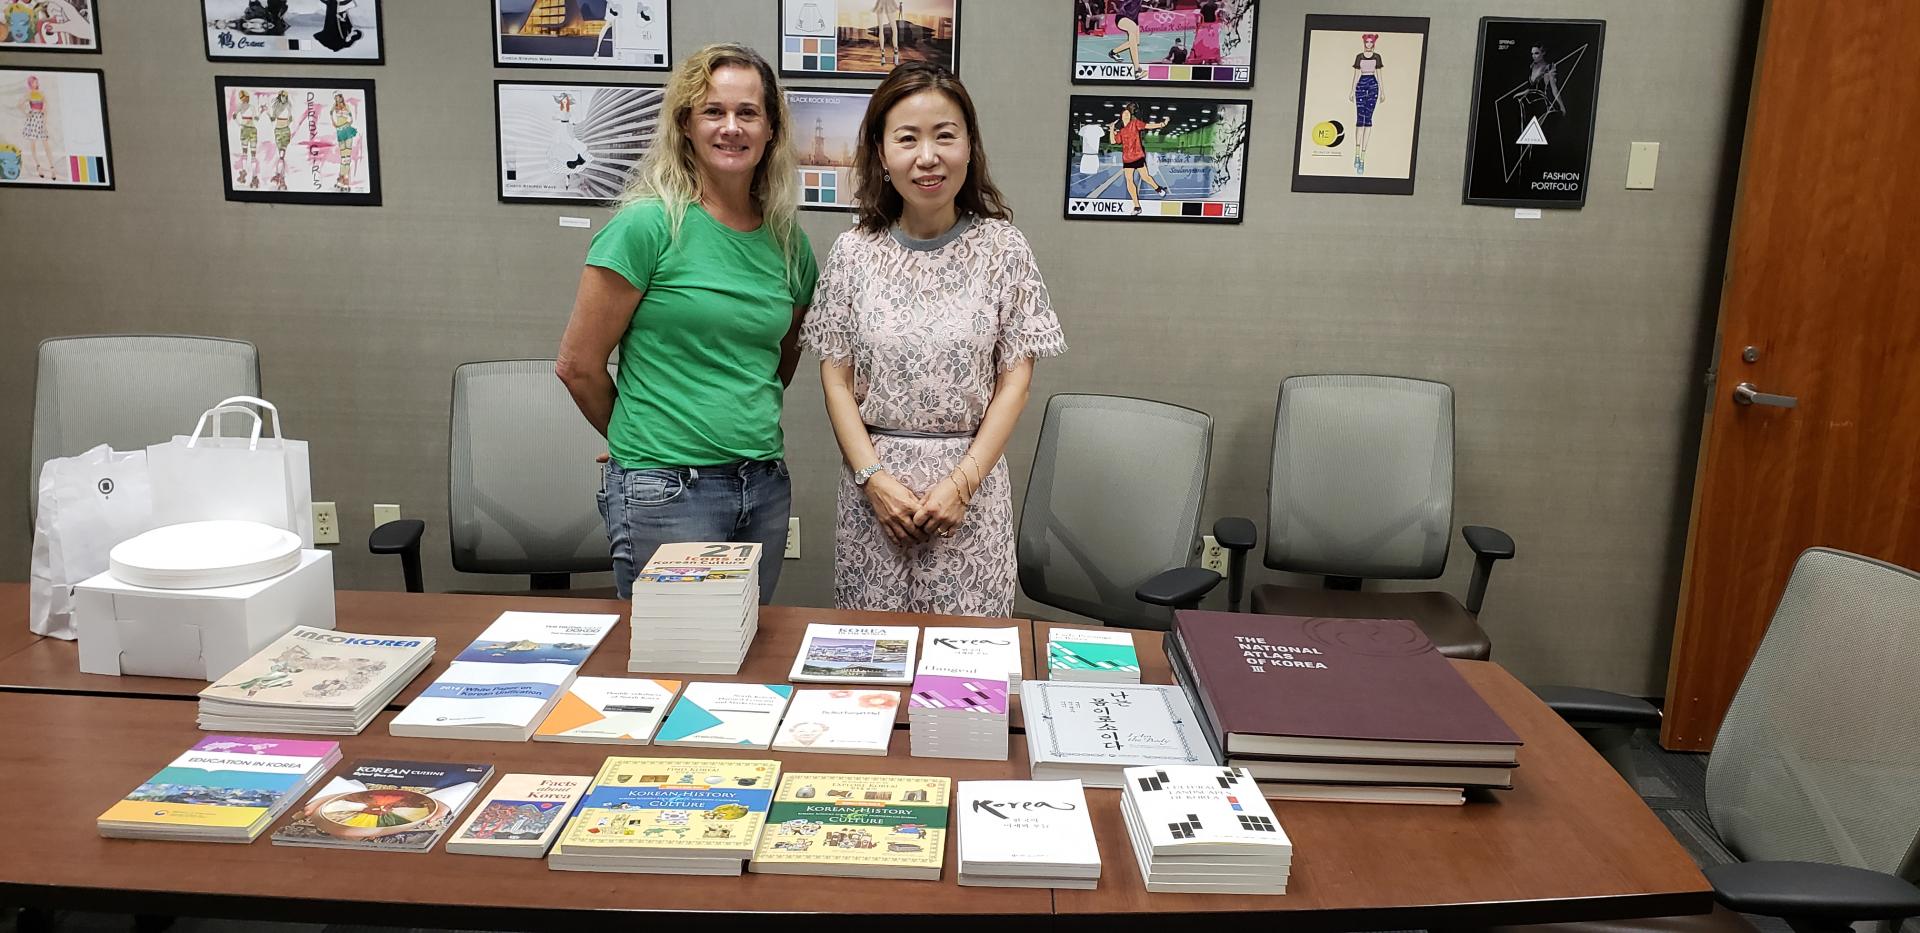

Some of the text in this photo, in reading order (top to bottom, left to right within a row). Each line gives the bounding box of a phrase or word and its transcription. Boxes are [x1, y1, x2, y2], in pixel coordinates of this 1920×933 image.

[238, 36, 265, 49] Crane
[1100, 65, 1133, 77] YONEX
[307, 92, 318, 140] DERBY
[310, 144, 322, 190] GIRLS
[1542, 171, 1580, 181] FASHION
[1531, 181, 1579, 191] PORTFOLIO
[1092, 201, 1124, 213] YONEX
[699, 544, 754, 558] 21
[839, 627, 887, 635] KOREA
[933, 637, 1012, 649] Korea
[1234, 635, 1267, 644] THE
[1238, 643, 1324, 655] NATIONAL
[1243, 650, 1294, 660] ATLAS
[1246, 657, 1329, 669] OF KOREA
[1250, 665, 1266, 673] III
[188, 757, 252, 766] EDUCATION
[356, 766, 411, 775] KOREAN
[528, 791, 571, 799] Korea
[648, 800, 705, 808] CULTURE
[806, 805, 913, 815] KOREAN HISTORY
[972, 799, 1076, 820] Korea
[828, 816, 884, 824] CULTURE
